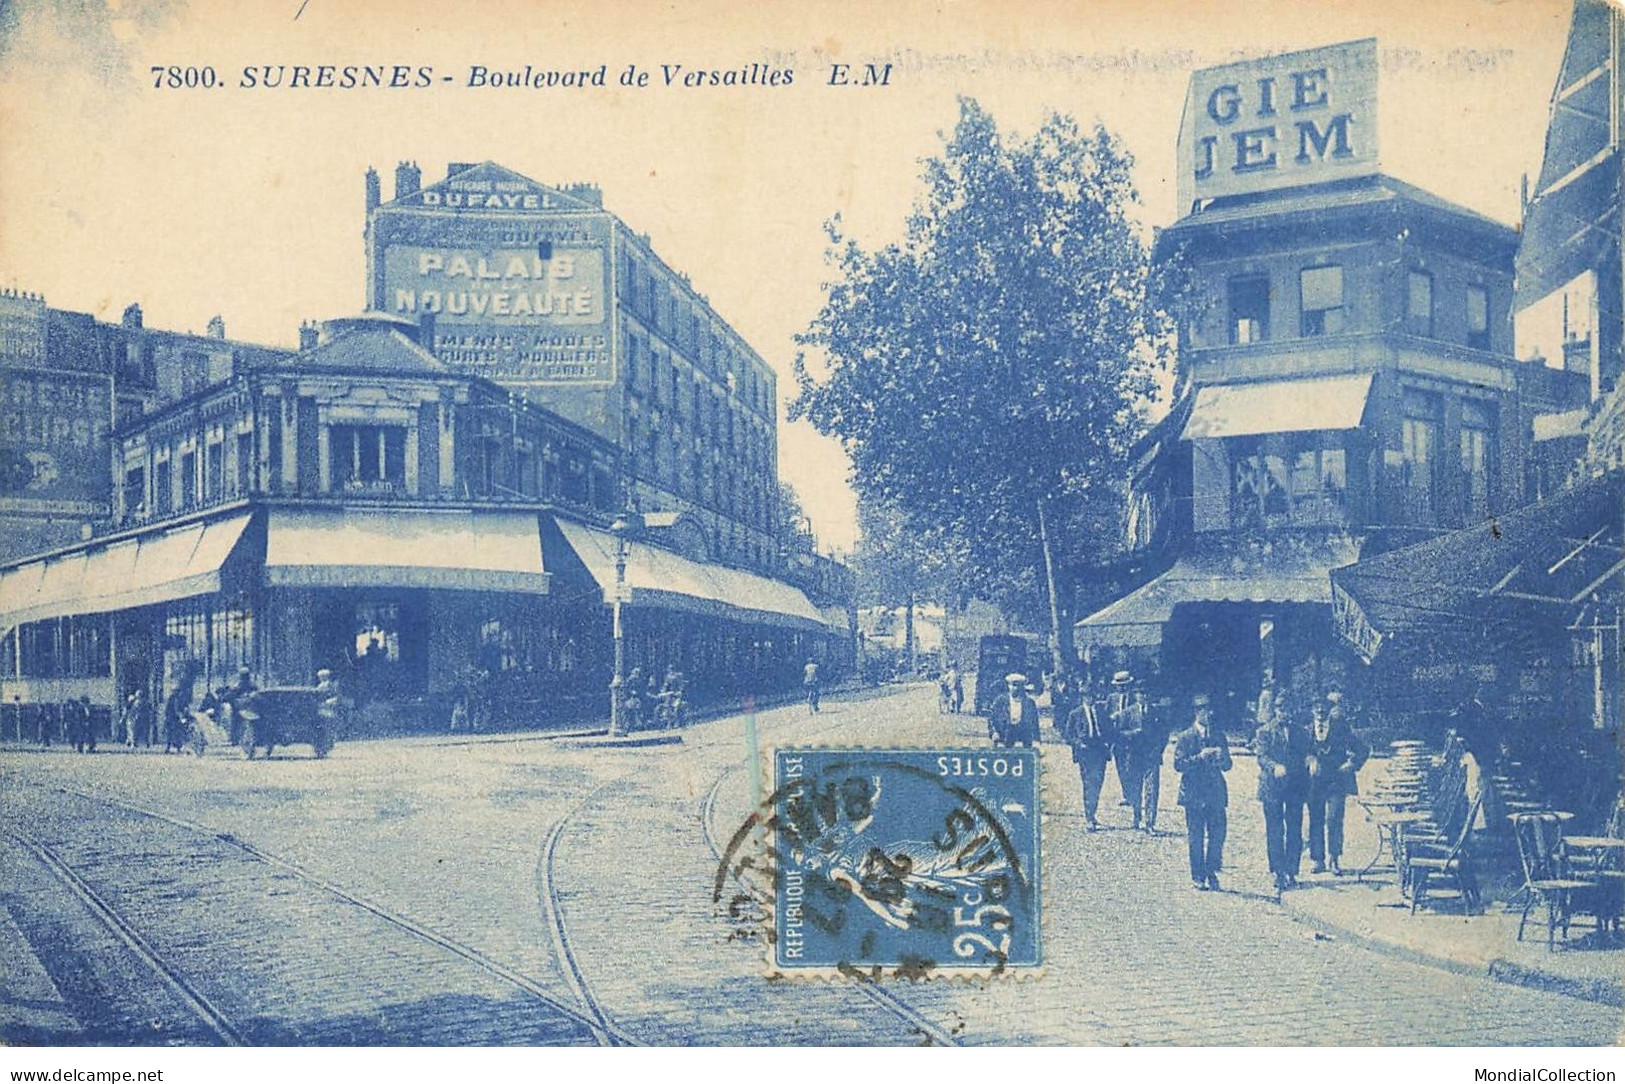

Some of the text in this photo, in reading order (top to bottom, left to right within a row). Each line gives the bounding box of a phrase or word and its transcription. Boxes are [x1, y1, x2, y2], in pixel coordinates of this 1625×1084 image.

[1206, 68, 1330, 127] GIE
[423, 192, 557, 208] DUFAYEL
[418, 252, 575, 279] PALAIS
[395, 286, 593, 316] NOUVEAUTÉ
[534, 333, 606, 350] MODES
[937, 757, 1024, 777] POSTES
